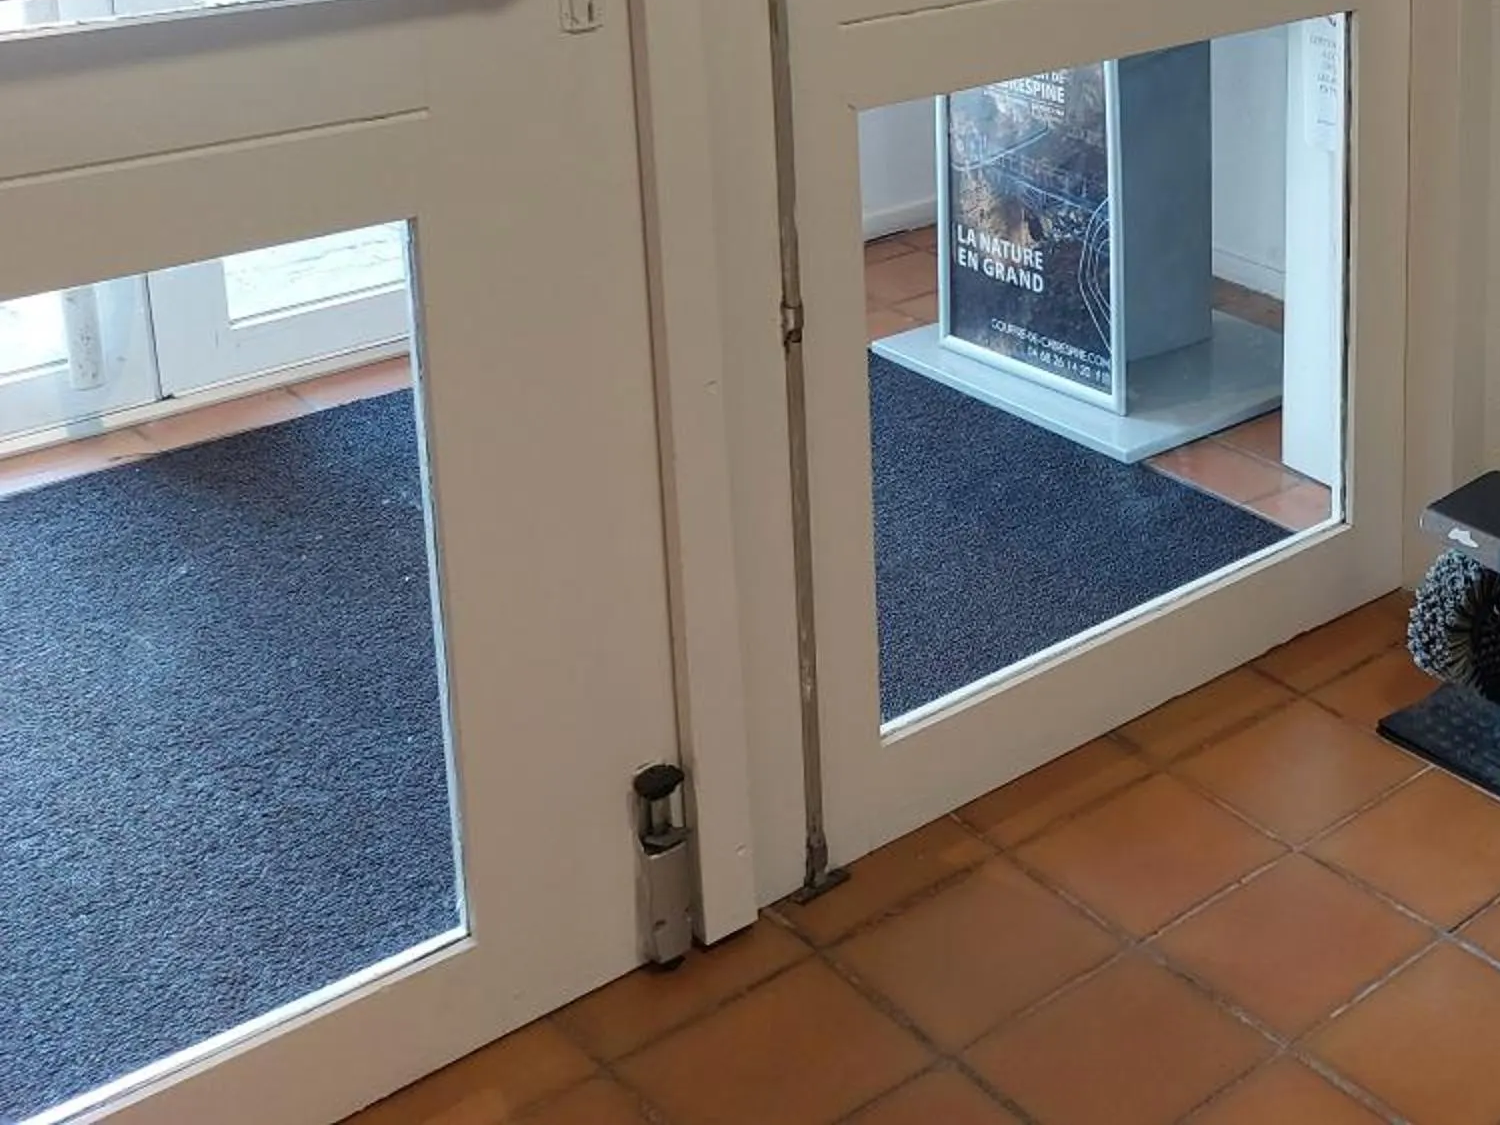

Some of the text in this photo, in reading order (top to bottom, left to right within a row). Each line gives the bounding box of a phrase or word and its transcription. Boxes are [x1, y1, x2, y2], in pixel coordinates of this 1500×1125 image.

[957, 225, 1044, 271] LA NATURE
[958, 247, 1044, 293] EN GRAND
